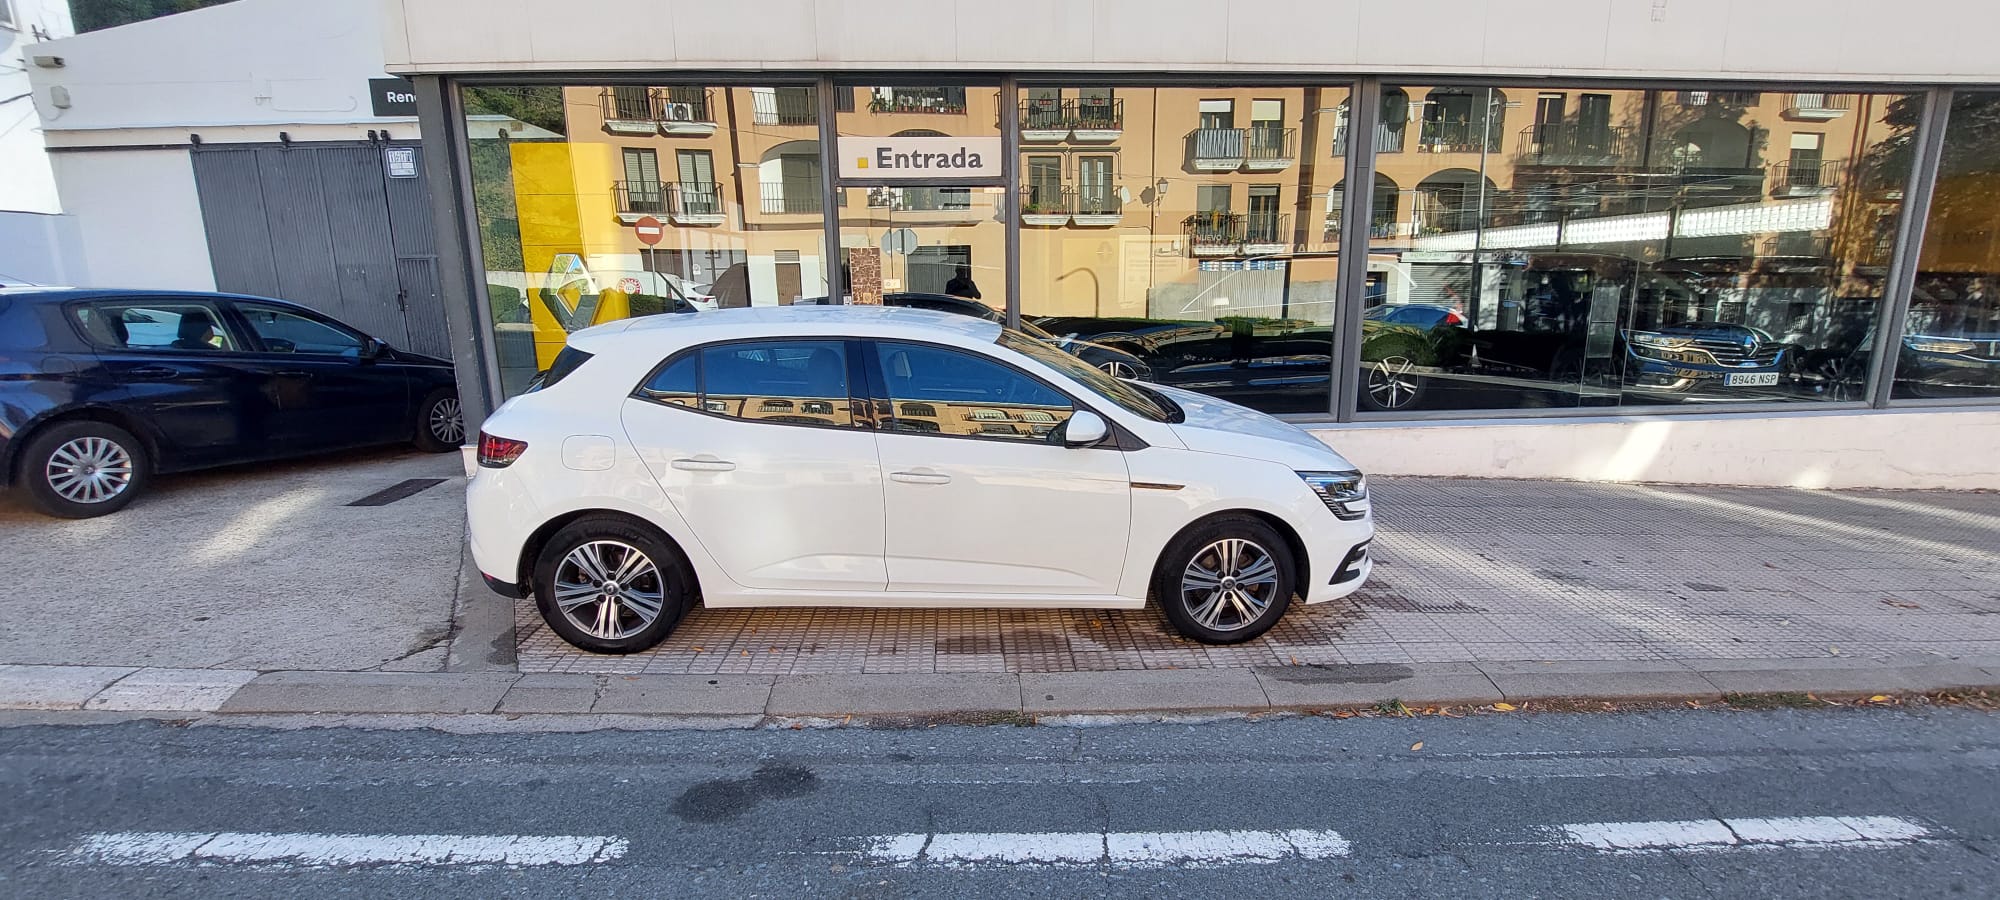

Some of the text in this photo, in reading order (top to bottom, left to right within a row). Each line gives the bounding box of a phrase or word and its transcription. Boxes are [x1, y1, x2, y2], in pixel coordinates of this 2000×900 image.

[876, 146, 983, 169] Entrada
[1731, 374, 1777, 385] 8946 NSP
